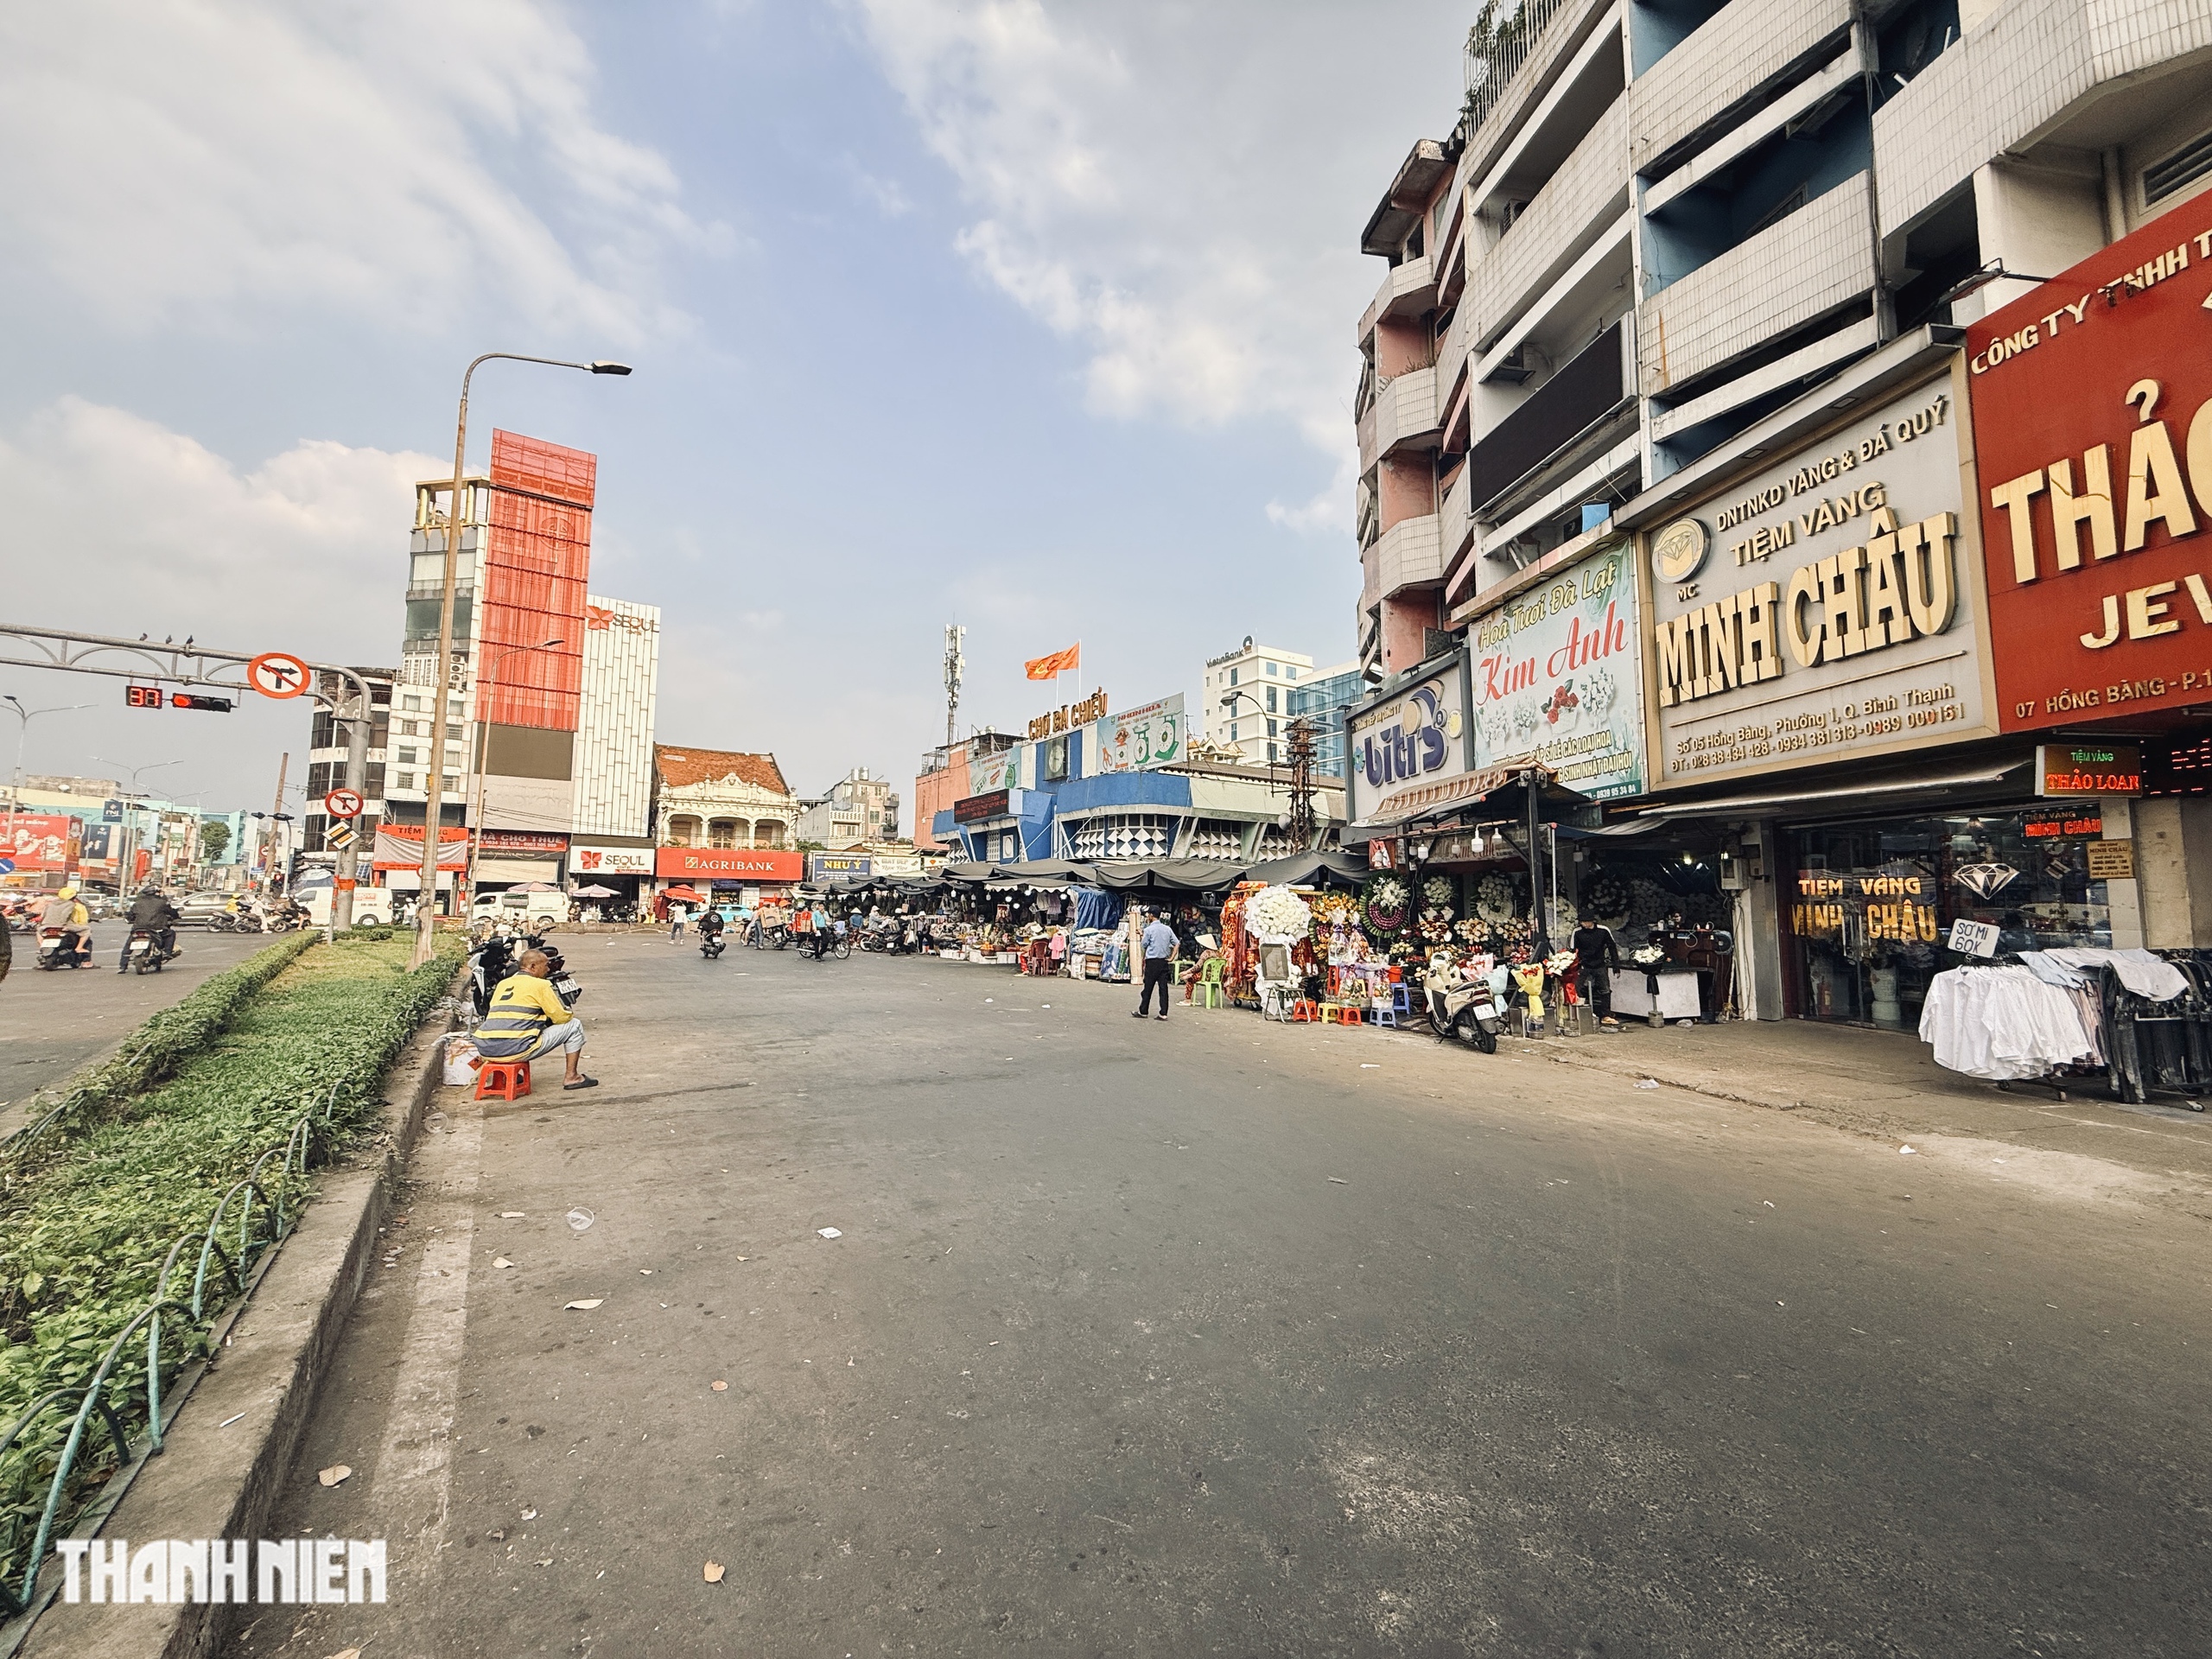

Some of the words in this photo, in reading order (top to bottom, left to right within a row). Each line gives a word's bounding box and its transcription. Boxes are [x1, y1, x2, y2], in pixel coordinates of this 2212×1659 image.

[1971, 325, 2039, 374] CÔNG
[2040, 294, 2091, 337] TY
[2097, 243, 2189, 307] TNHH
[1716, 484, 1786, 532] DNTNKD
[1785, 457, 1840, 497] VÀNG
[1859, 423, 1891, 461] ĐÁ
[1894, 394, 1948, 442] QUÝ
[1730, 520, 1795, 567] TIỆM
[1798, 481, 1887, 537] VÀNG
[1676, 582, 1698, 602] MC
[1479, 620, 1510, 652] Hoa
[1512, 594, 1547, 634] Tươi
[1549, 580, 1578, 615] Đà
[1582, 561, 1617, 601] Lạt
[1656, 582, 1783, 709] MINH
[1785, 506, 1956, 668] CHÂU
[2079, 574, 2212, 649] JE
[612, 613, 659, 632] SEOUL
[1205, 648, 1244, 669] VietinBank
[1476, 653, 1538, 706] Kim
[1547, 600, 1629, 678] Anh
[130, 688, 160, 707] 37
[2015, 701, 2036, 718] 07
[2046, 688, 2101, 714] HỒNG
[1028, 710, 1051, 741] CHỢ
[1693, 738, 1705, 751] 05
[1863, 695, 1897, 715] Bình
[1903, 683, 1955, 706] Thạnh
[1562, 736, 1577, 756] CÁC
[1578, 733, 1595, 754] LOẠI
[1596, 729, 1611, 751] HOA
[1711, 751, 1725, 765] 38
[1726, 745, 1746, 761] 434
[1748, 741, 1770, 757] 428
[1808, 729, 1832, 747] 381
[1564, 763, 1581, 782] SINH
[1582, 756, 1601, 779] NHẬT
[1603, 753, 1618, 776] ĐẠI
[1618, 748, 1632, 772] HỘI
[2071, 749, 2090, 764] TIỆM
[2092, 749, 2113, 762] VÀNG
[1596, 789, 1611, 799] 0939
[1611, 787, 1618, 796] 95
[1628, 784, 1637, 793] 84
[2046, 768, 2094, 790] THẢO
[2095, 775, 2140, 790] LOAN
[2049, 810, 2075, 819] VÀNG
[2063, 817, 2101, 835] CHÂU
[500, 834, 527, 842] CHO
[531, 836, 563, 844] THUÊ
[605, 855, 645, 866] SEOUL
[699, 860, 775, 871] AGRIBANK
[1798, 877, 1843, 899] TIỆM
[1859, 874, 1922, 896] VÀNG
[1867, 899, 1937, 942] CHÂU
[1955, 936, 1982, 954] 60K
